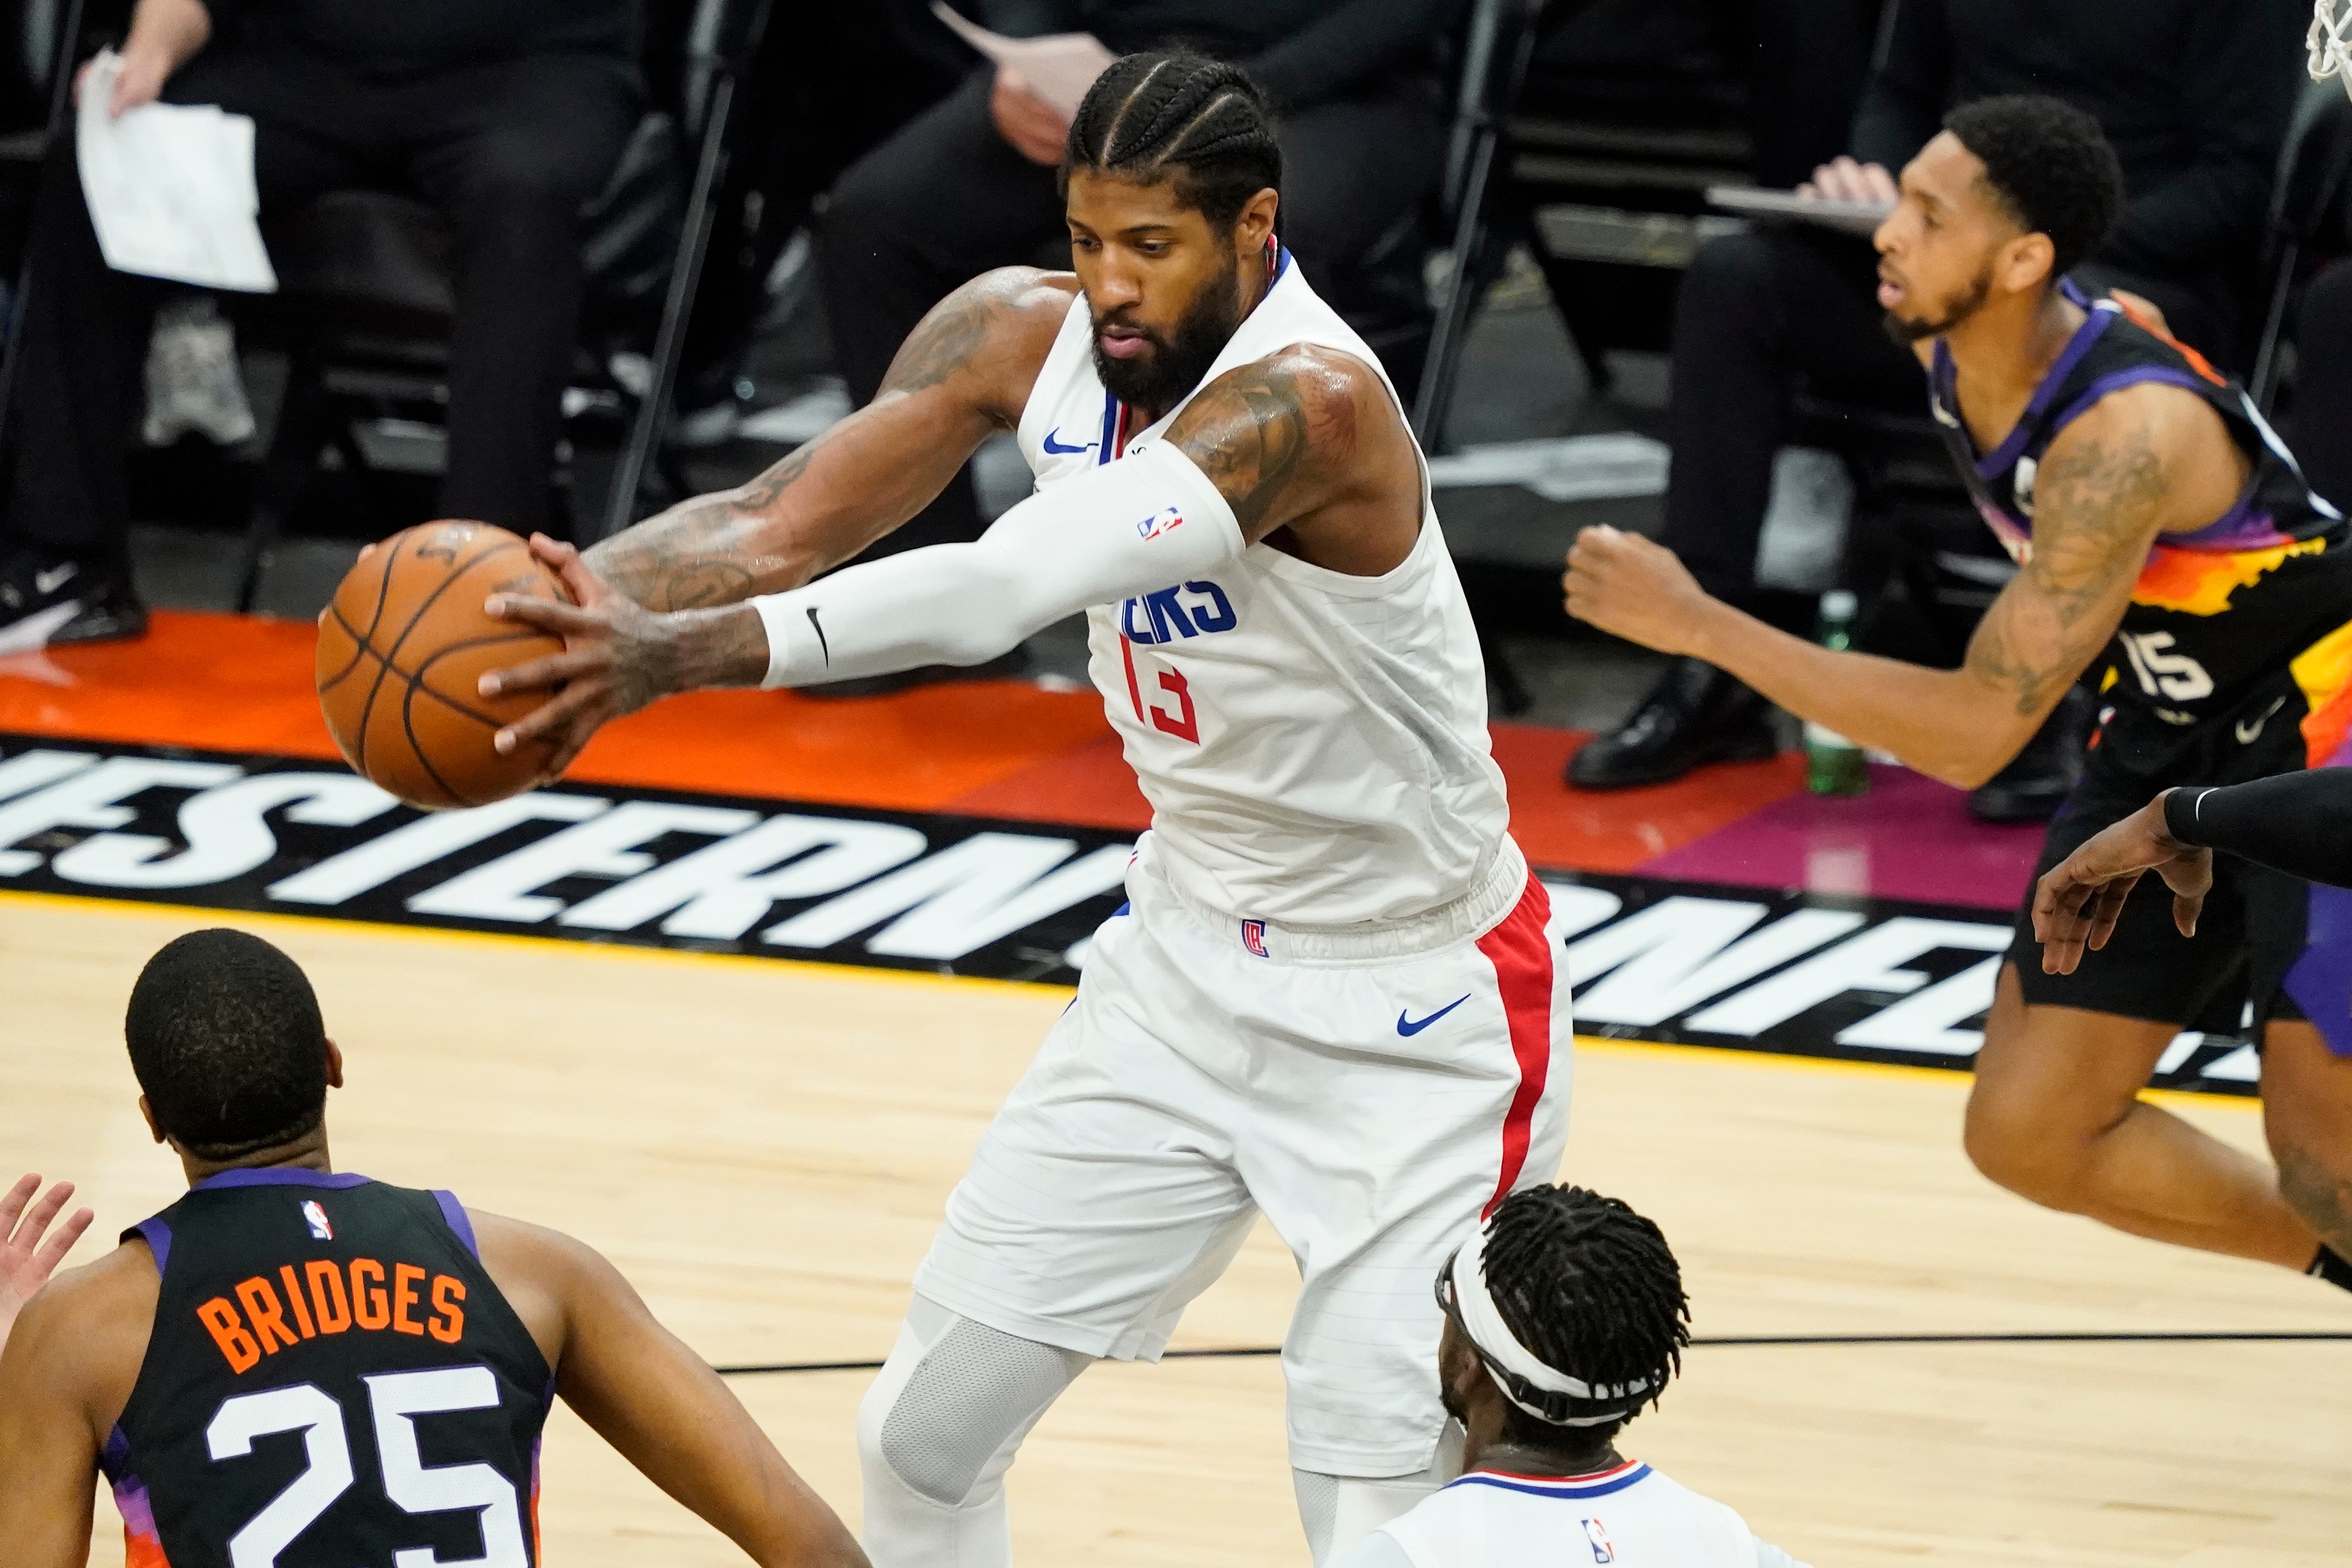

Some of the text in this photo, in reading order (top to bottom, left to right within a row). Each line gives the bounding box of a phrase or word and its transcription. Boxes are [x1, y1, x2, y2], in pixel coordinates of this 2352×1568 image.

[1118, 632, 1200, 746] 13
[2119, 631, 2214, 701] 15
[196, 1258, 467, 1375] BRIDGES
[205, 1363, 530, 1568] 25
